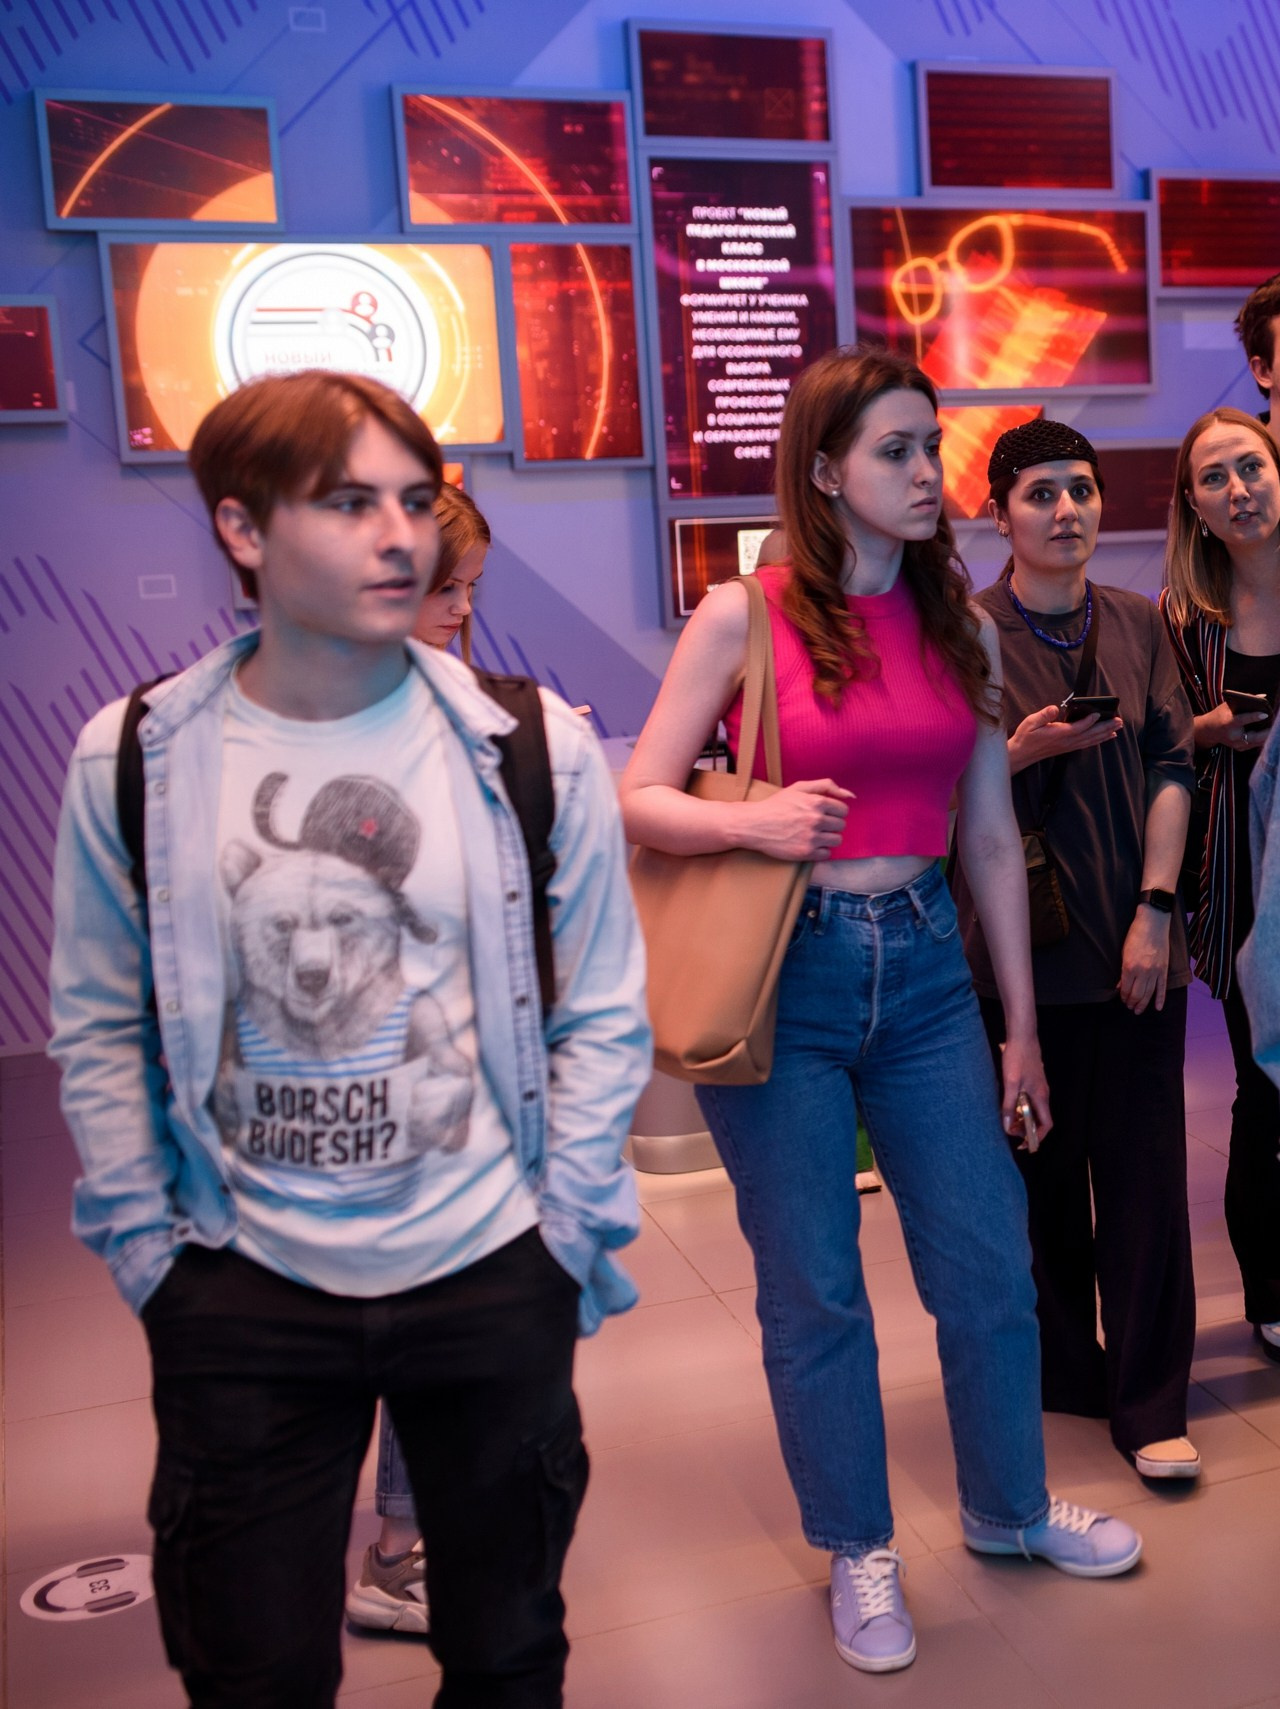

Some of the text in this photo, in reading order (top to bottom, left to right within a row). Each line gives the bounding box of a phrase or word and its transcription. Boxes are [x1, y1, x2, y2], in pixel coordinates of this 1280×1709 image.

[692, 206, 736, 220] ПРОЕКТ
[256, 1078, 389, 1126] BORSCH
[248, 1117, 397, 1167] BUDESH?
